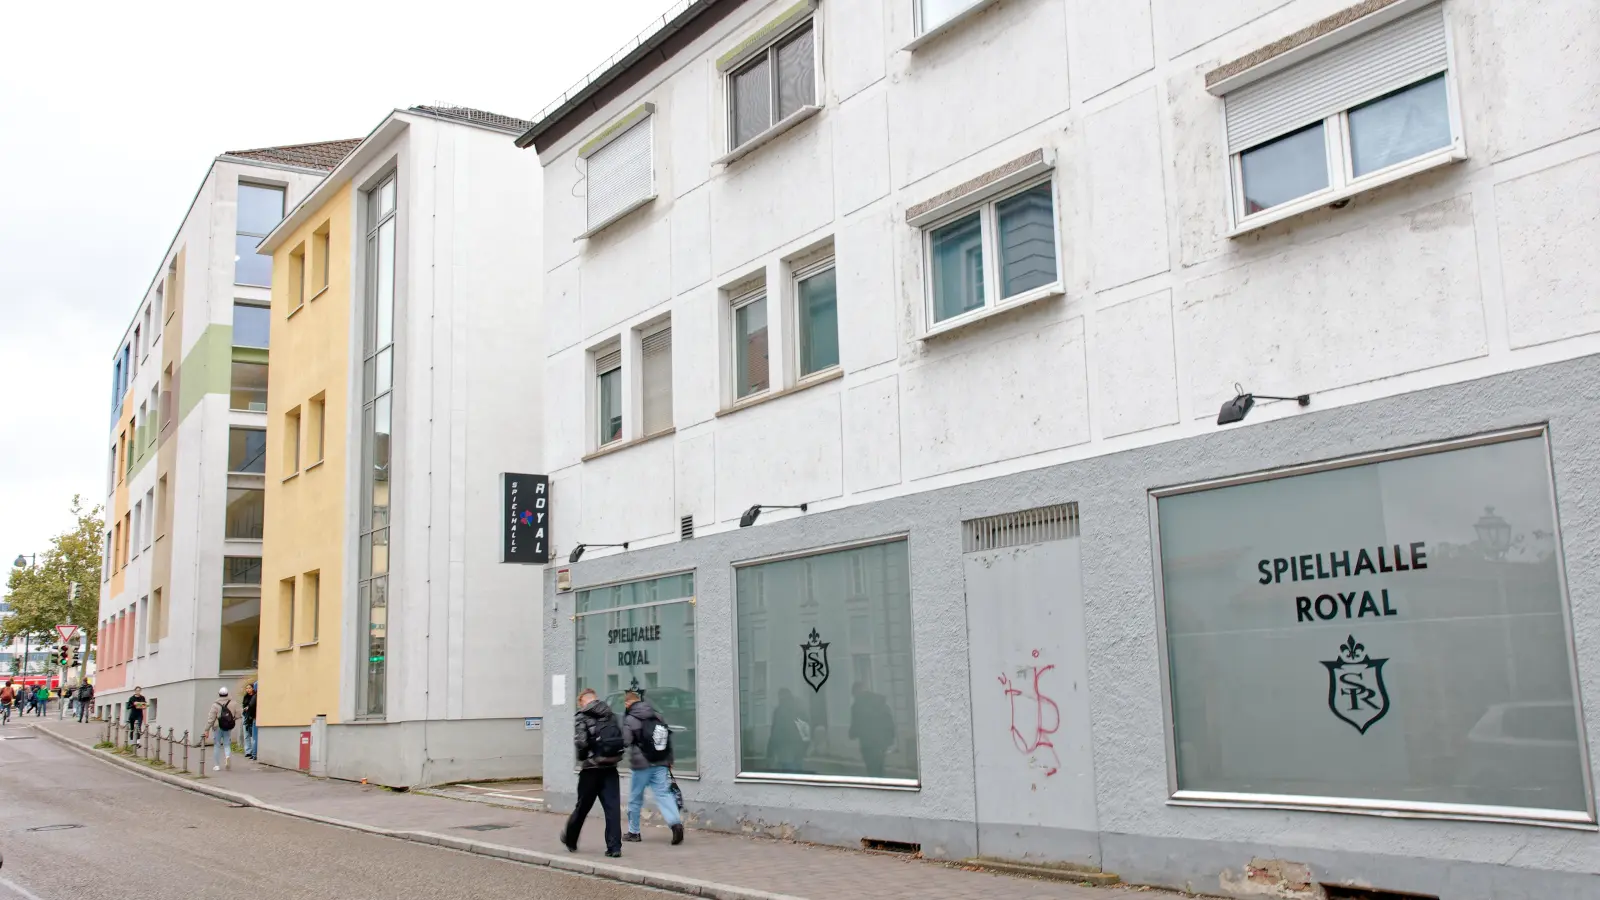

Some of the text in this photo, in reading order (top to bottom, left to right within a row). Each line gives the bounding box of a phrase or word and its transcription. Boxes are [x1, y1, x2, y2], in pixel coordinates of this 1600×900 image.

[535, 483, 545, 553] ROYAL
[1258, 541, 1428, 585] SPIELHALLE
[1296, 588, 1398, 622] ROYAL
[608, 624, 661, 645] SPIELHALLE
[618, 649, 650, 667] ROYAL
